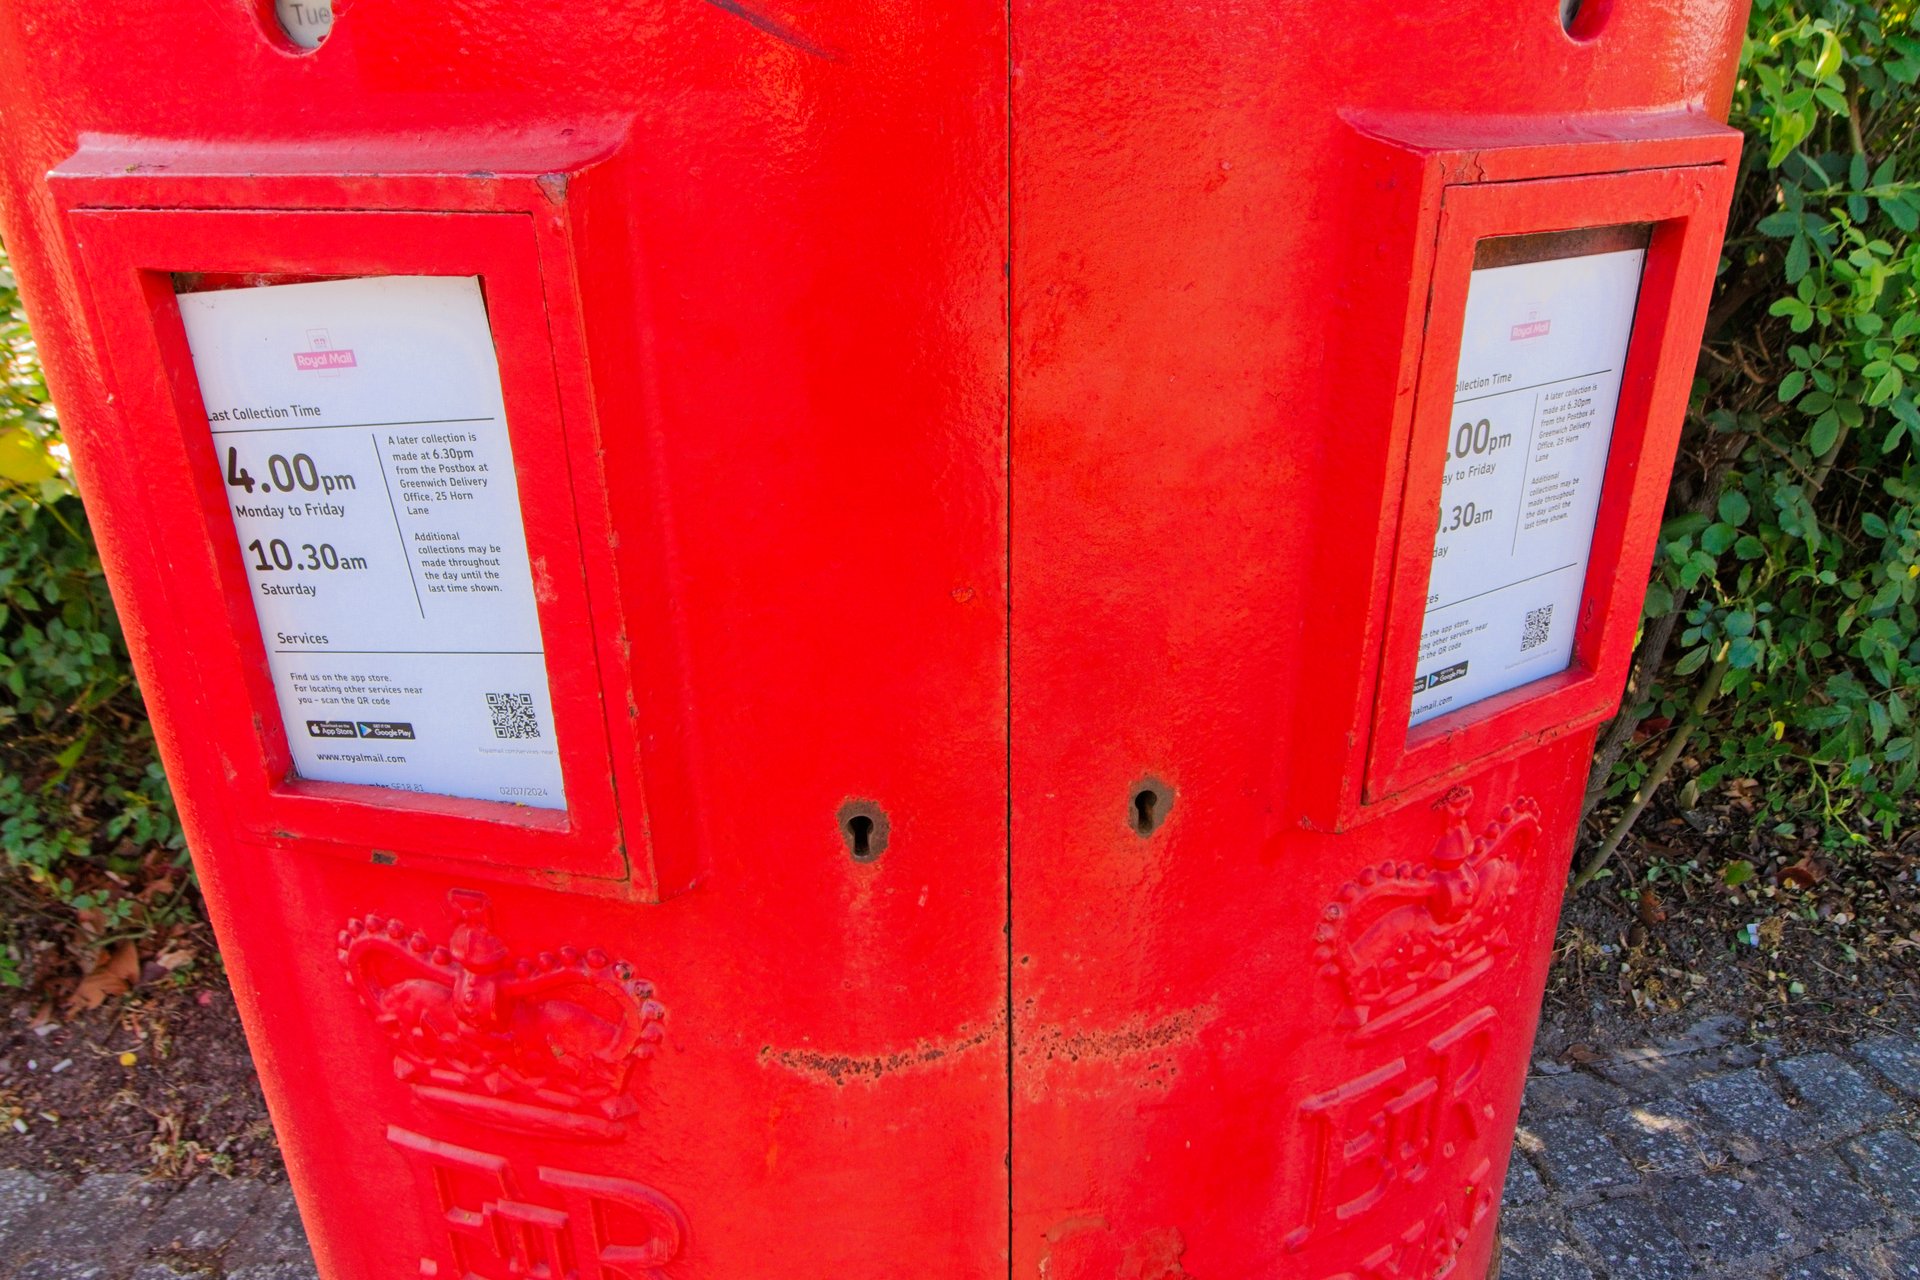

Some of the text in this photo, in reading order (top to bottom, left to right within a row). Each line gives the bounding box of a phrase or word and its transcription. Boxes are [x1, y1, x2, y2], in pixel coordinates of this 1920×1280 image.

[290, 3, 331, 25] Tue
[297, 353, 352, 367] Royal Mail
[1455, 372, 1512, 392] ollection Time
[1550, 392, 1564, 400] later
[1565, 386, 1591, 397] collection
[232, 406, 288, 421] Collection
[290, 405, 321, 417] Time
[1543, 398, 1591, 415] made at 6.30pm
[1541, 419, 1555, 428] from
[1567, 411, 1588, 421] Postbox
[1539, 421, 1591, 439] Greenwich Delivery
[388, 432, 477, 445] A later collection is
[1446, 418, 1512, 461] .00pm
[1556, 437, 1564, 446] 25
[392, 448, 474, 461] made at 6.30pm
[227, 446, 356, 495] 4.00pm
[396, 463, 489, 475] from the Postbox at
[1456, 470, 1465, 481] to
[1468, 462, 1496, 479] Friday
[399, 476, 488, 488] Greenwich Delivery
[403, 491, 474, 502] Office, 25 Horn
[1528, 499, 1544, 508] made
[235, 503, 345, 519] Monday to Friday
[406, 506, 430, 515] Lane
[1435, 502, 1493, 534] .30am
[414, 532, 460, 541] Additional
[248, 538, 368, 571] 10.30am
[418, 544, 501, 555] collections may be
[421, 558, 501, 568] made throughout
[424, 570, 500, 581] the day until the
[261, 583, 316, 597] Saturday
[428, 584, 503, 593] last time shown.
[1429, 627, 1440, 637] the
[1442, 624, 1453, 635] app
[1432, 636, 1449, 648] other
[1450, 628, 1474, 641] services
[1475, 623, 1488, 633] near
[277, 632, 329, 644] Services
[1426, 650, 1437, 660] the
[1438, 646, 1447, 655] QR
[1448, 641, 1462, 651] code
[290, 672, 308, 681] Find
[310, 674, 320, 682] us
[334, 673, 348, 682] the
[350, 675, 366, 684] app
[368, 674, 392, 682] store.
[294, 684, 307, 692] For
[309, 684, 342, 694] locating
[344, 685, 365, 694] other
[367, 686, 402, 694] services
[298, 697, 313, 705] you
[341, 697, 355, 705] the
[357, 696, 369, 705] QR
[371, 697, 391, 705] code
[1410, 695, 1453, 718] yalmail.com
[322, 727, 335, 735] App
[375, 729, 412, 738] Google Play
[317, 753, 406, 763] www.royalmail.com
[499, 787, 548, 797] 02/07/2024
